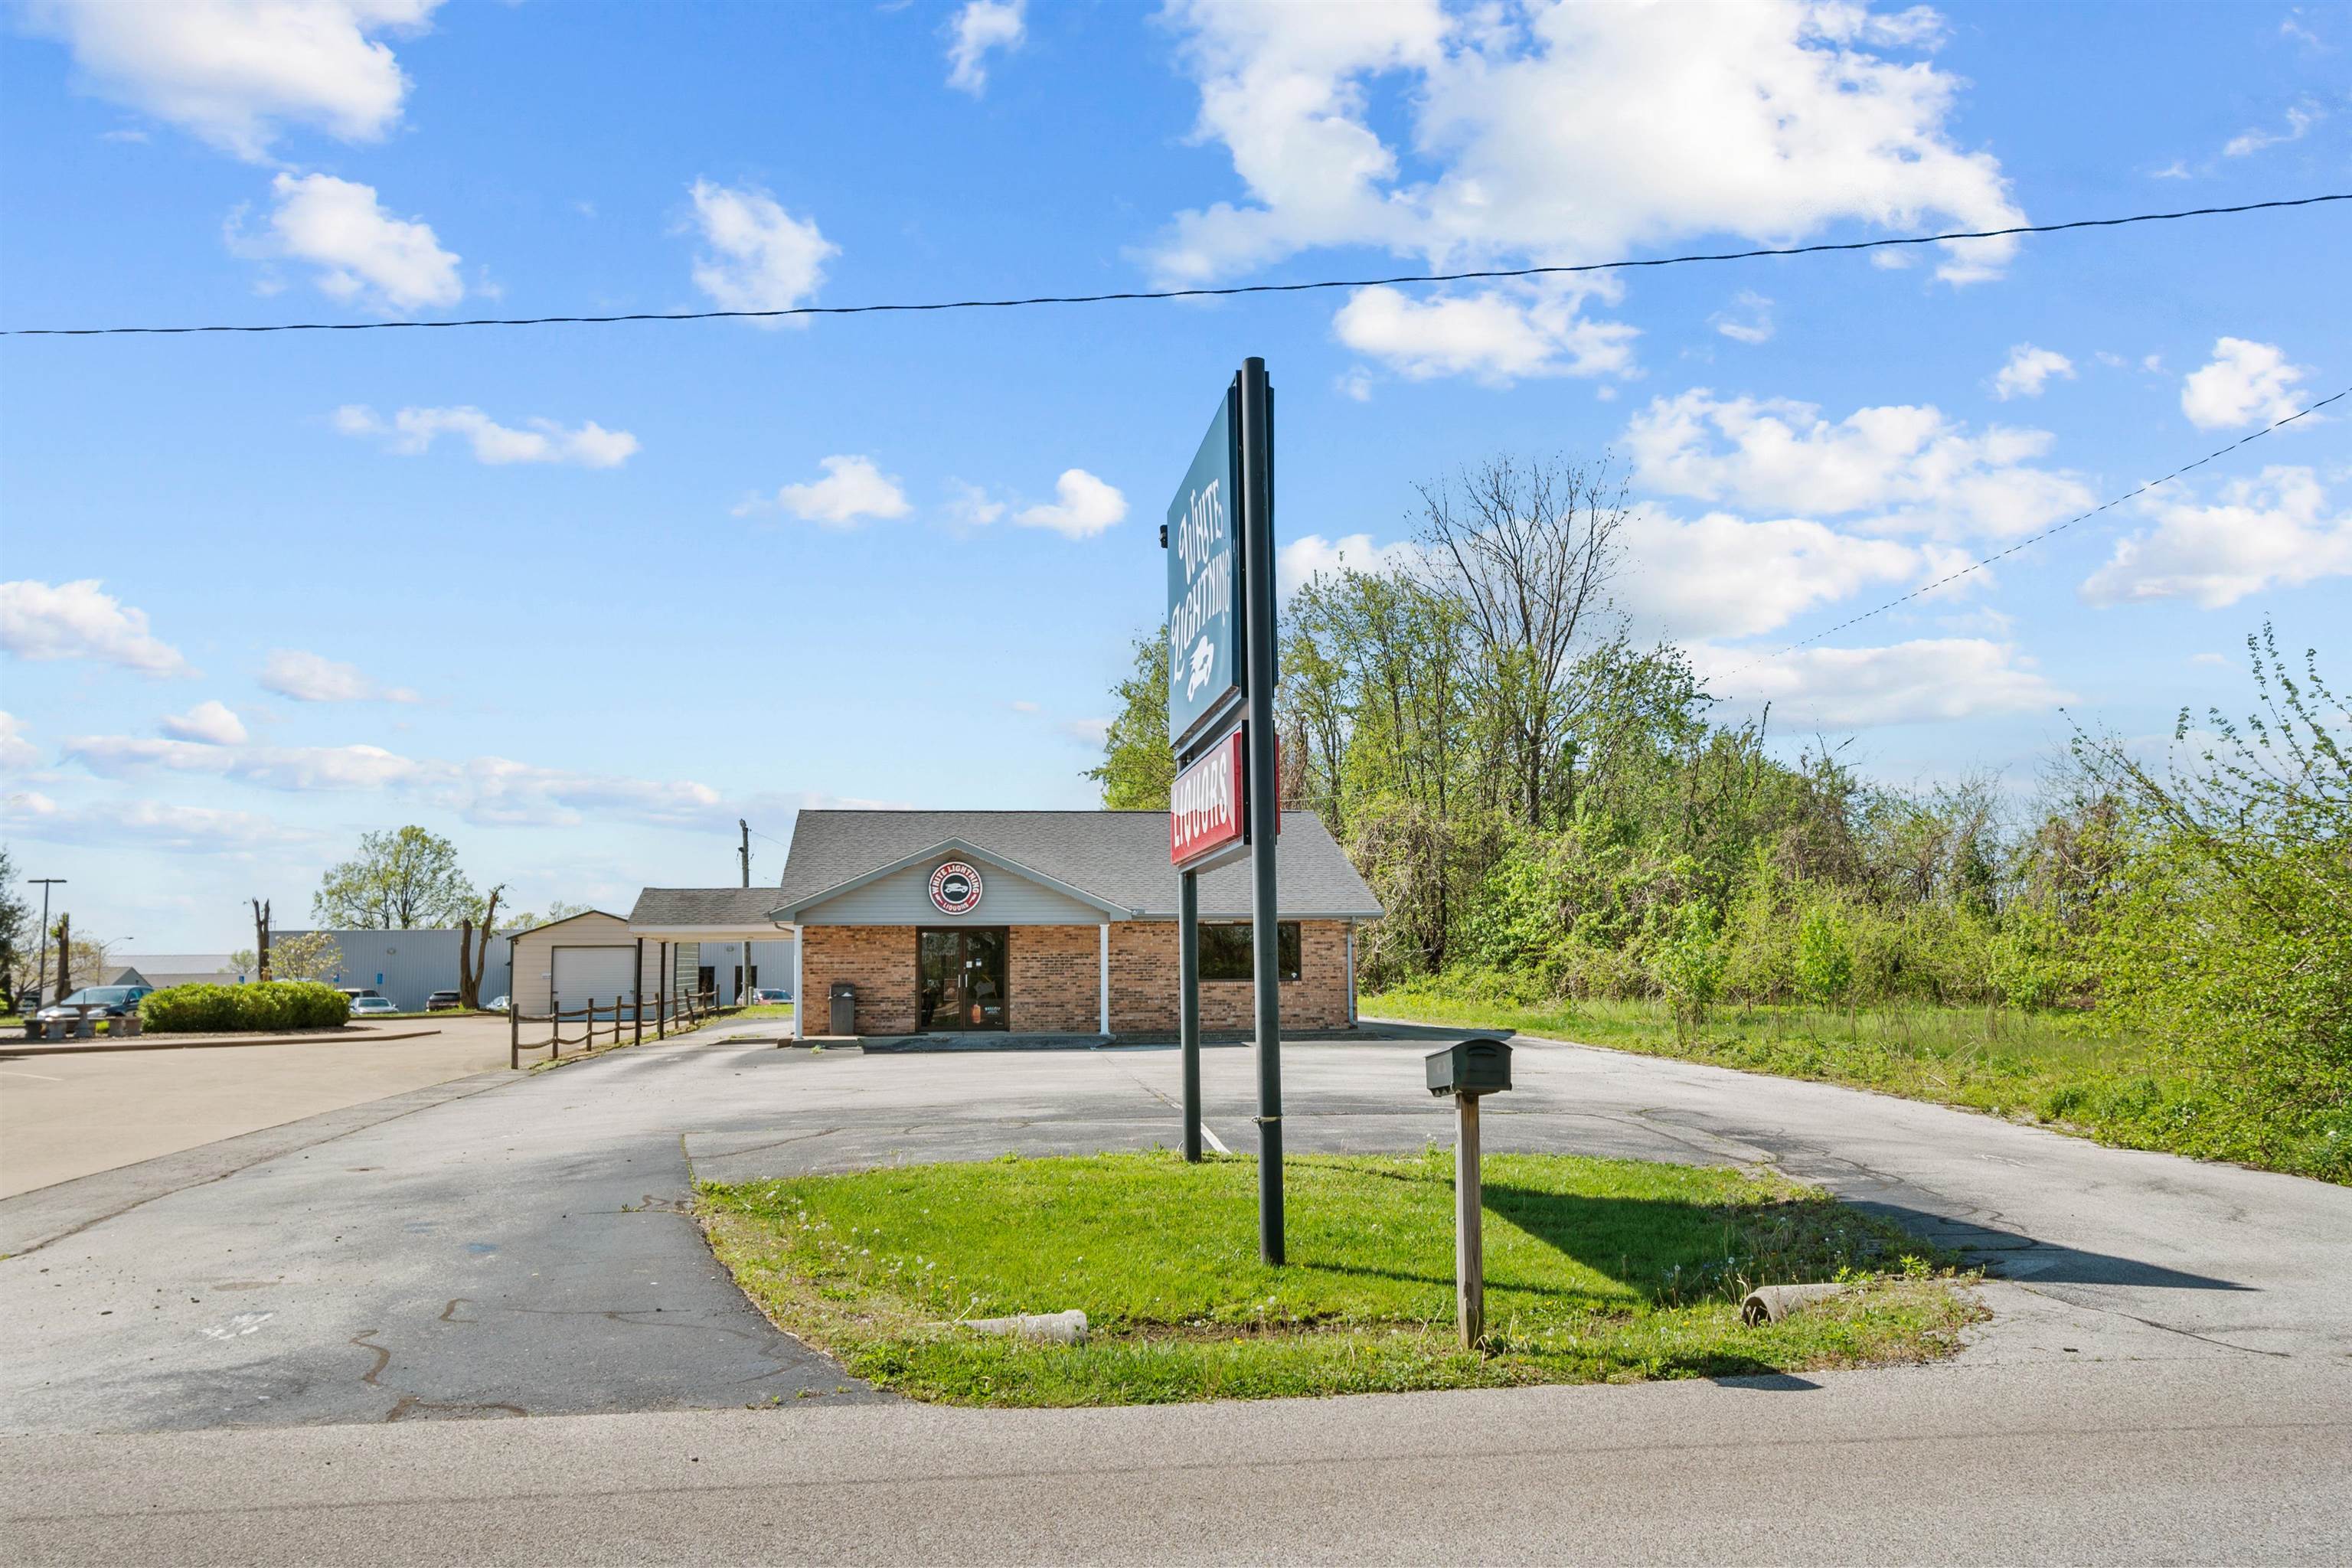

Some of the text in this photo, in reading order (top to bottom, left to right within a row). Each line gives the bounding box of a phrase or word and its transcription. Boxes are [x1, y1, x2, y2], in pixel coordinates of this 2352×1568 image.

[1178, 479, 1223, 585] WHITE
[1171, 549, 1230, 686] LIGHTNING
[1174, 752, 1227, 849] LIQUORS
[932, 865, 979, 894] WHITE LIGHTNING
[942, 902, 969, 911] LIQUORS
